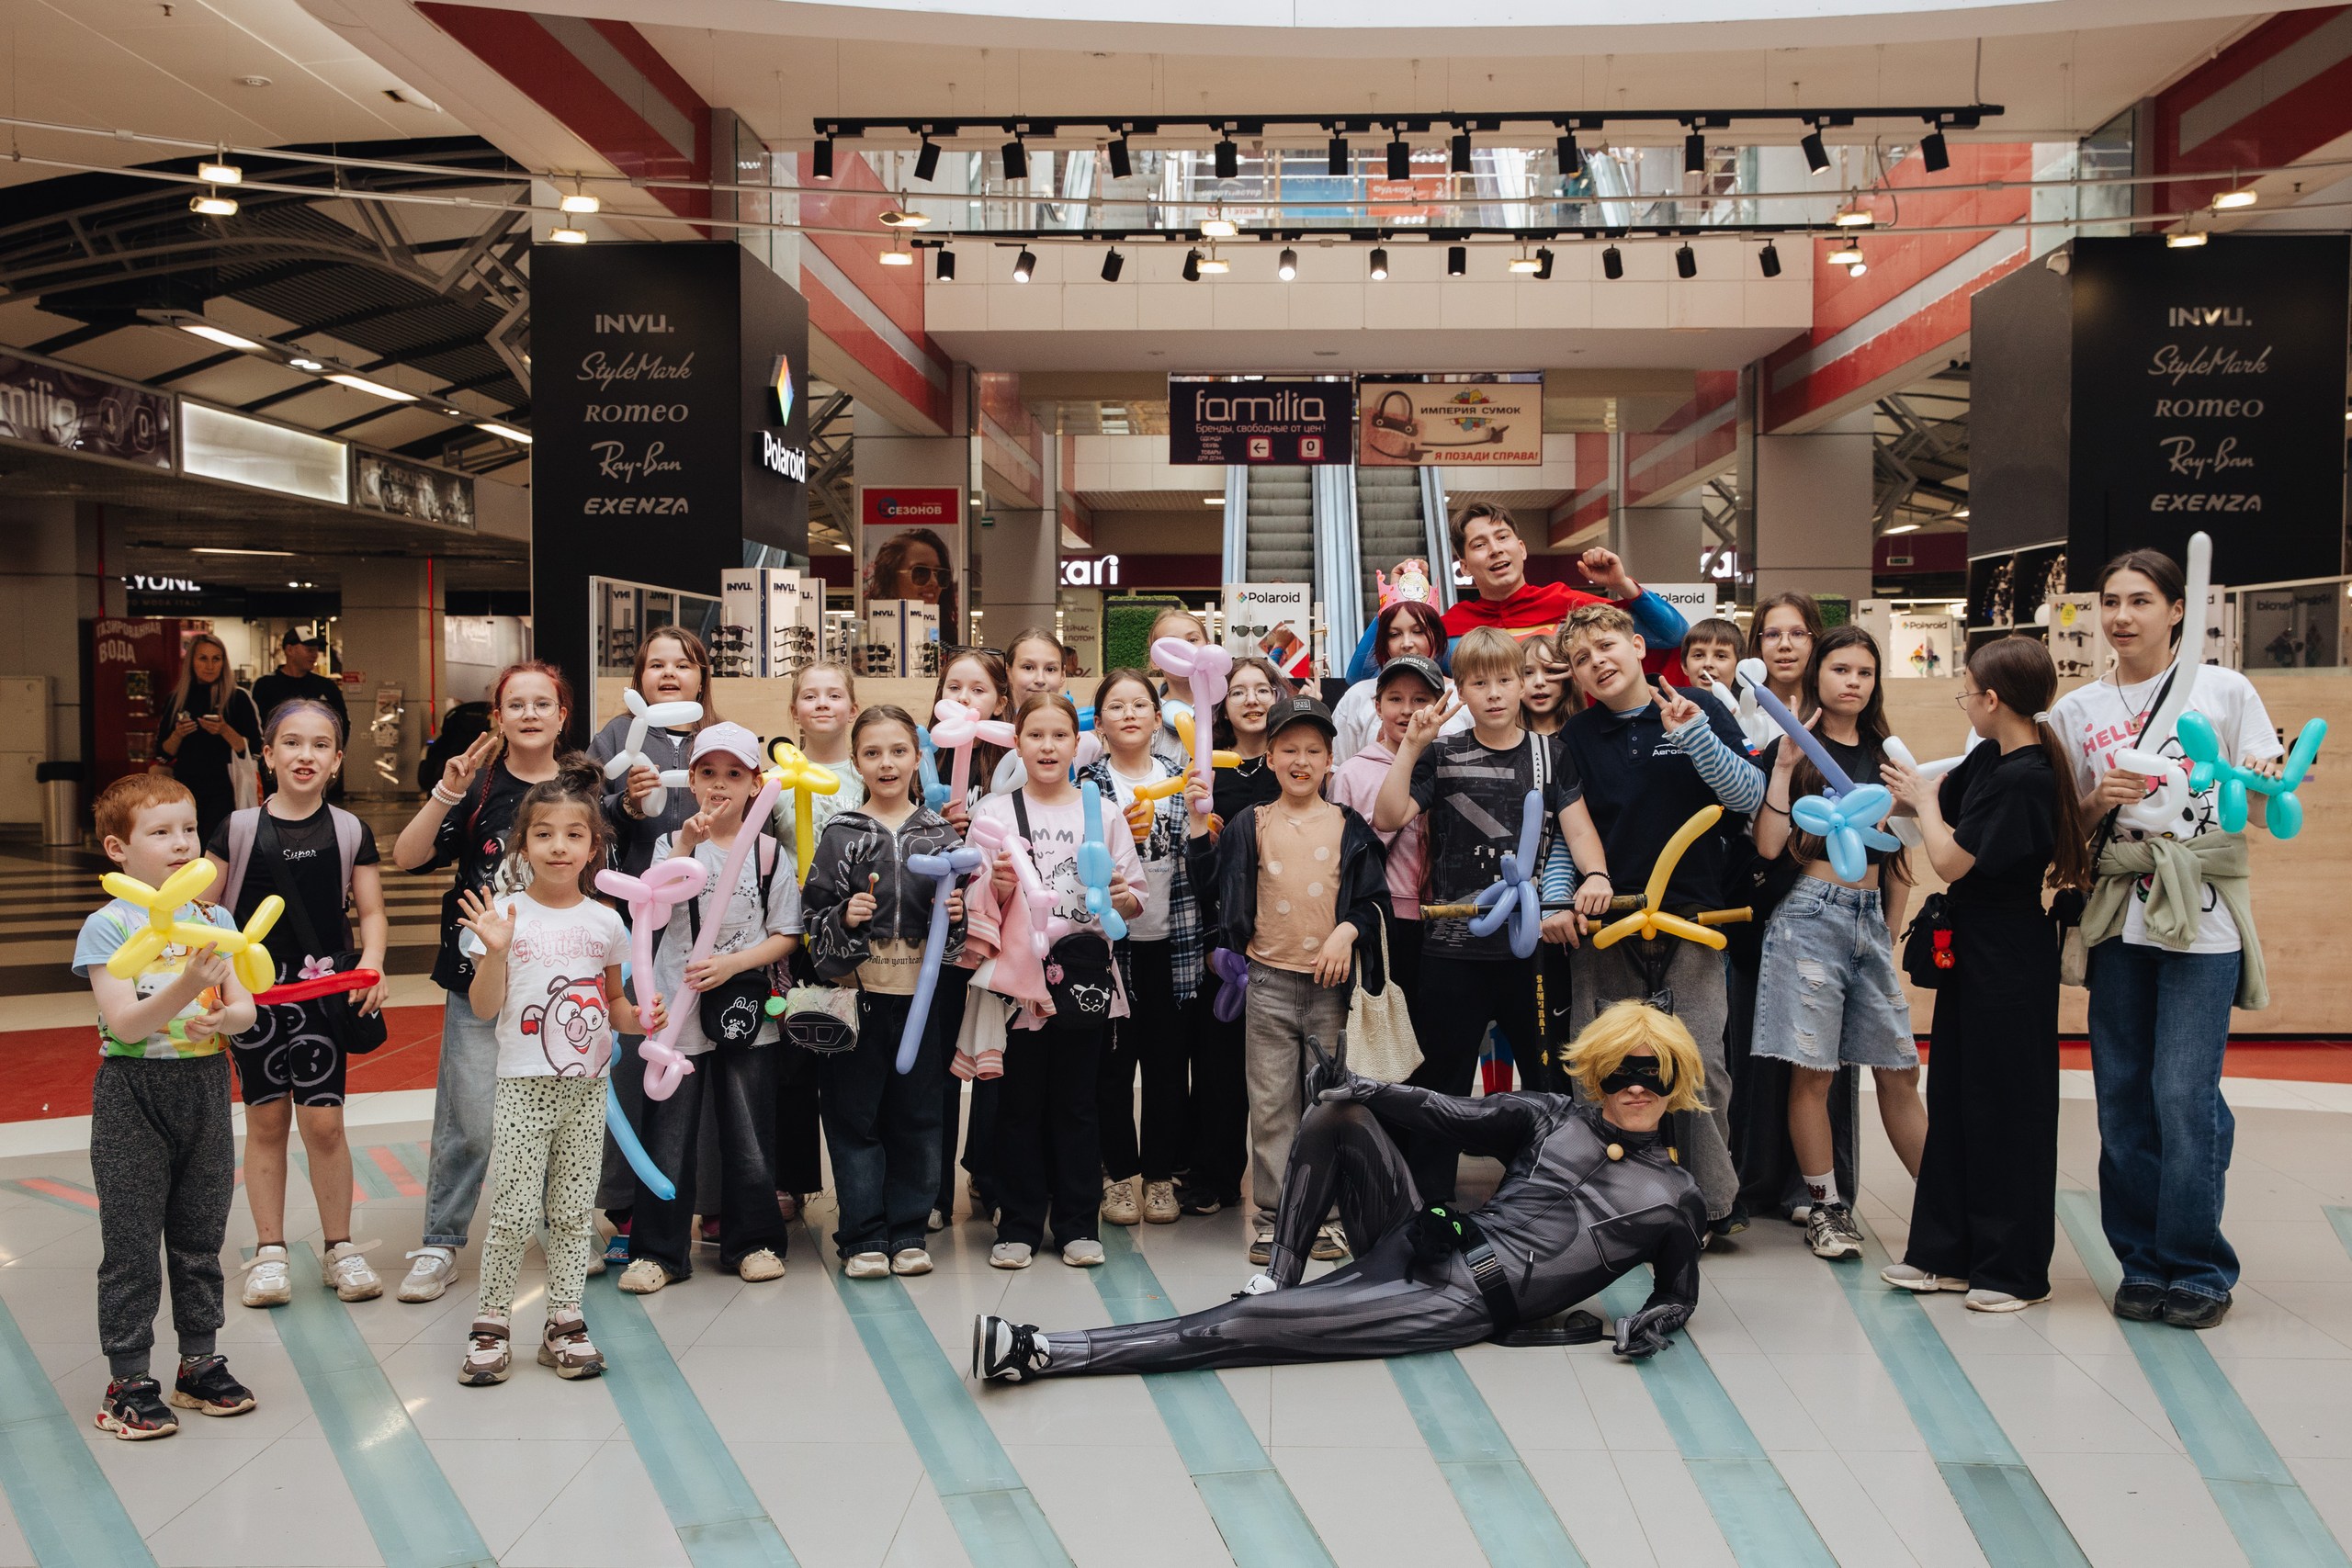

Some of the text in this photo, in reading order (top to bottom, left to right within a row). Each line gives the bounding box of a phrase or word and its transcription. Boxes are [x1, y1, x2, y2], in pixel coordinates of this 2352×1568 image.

[576, 351, 695, 391] StyleMark
[2147, 344, 2273, 387] StyleMark
[1196, 389, 1326, 422] familia
[1196, 423, 1234, 434] Бренды,
[1237, 423, 1288, 434] свободные
[1306, 440, 1315, 451] 0
[763, 430, 806, 484] Polaroid
[1434, 452, 1538, 461] Я ПОЗАДИ СПРАВА!
[583, 497, 689, 515] EXENZA
[2150, 494, 2261, 512] EXENZA
[1249, 592, 1300, 603] Polaroid
[96, 620, 163, 639] ГАЗИРОВАННАЯ
[1910, 621, 1948, 629] Polaroid
[98, 639, 137, 664] ВОДА
